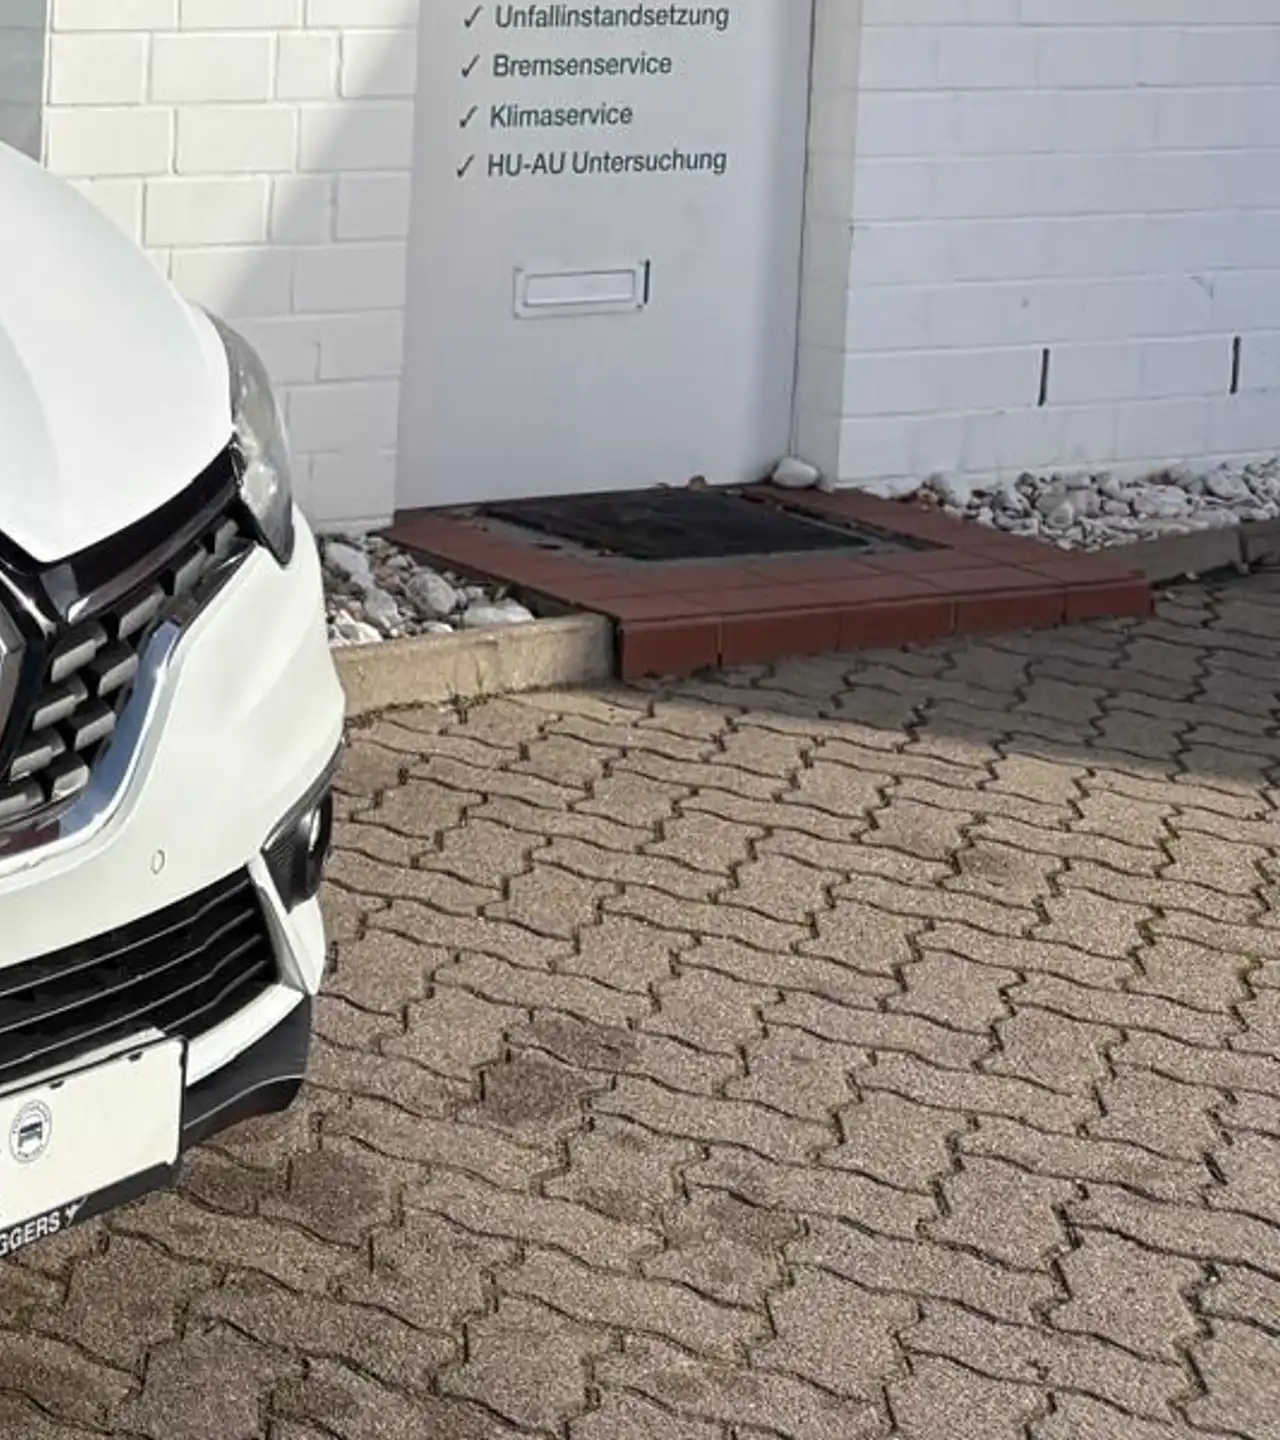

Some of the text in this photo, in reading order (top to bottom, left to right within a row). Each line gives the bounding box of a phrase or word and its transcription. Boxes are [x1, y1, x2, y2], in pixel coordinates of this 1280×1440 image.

[496, 3, 729, 31] Unfallinstandsetzung
[493, 52, 672, 77] Bremsenservice
[491, 103, 633, 128] Klimaservice
[488, 149, 726, 176] HU-AU Untersuchung
